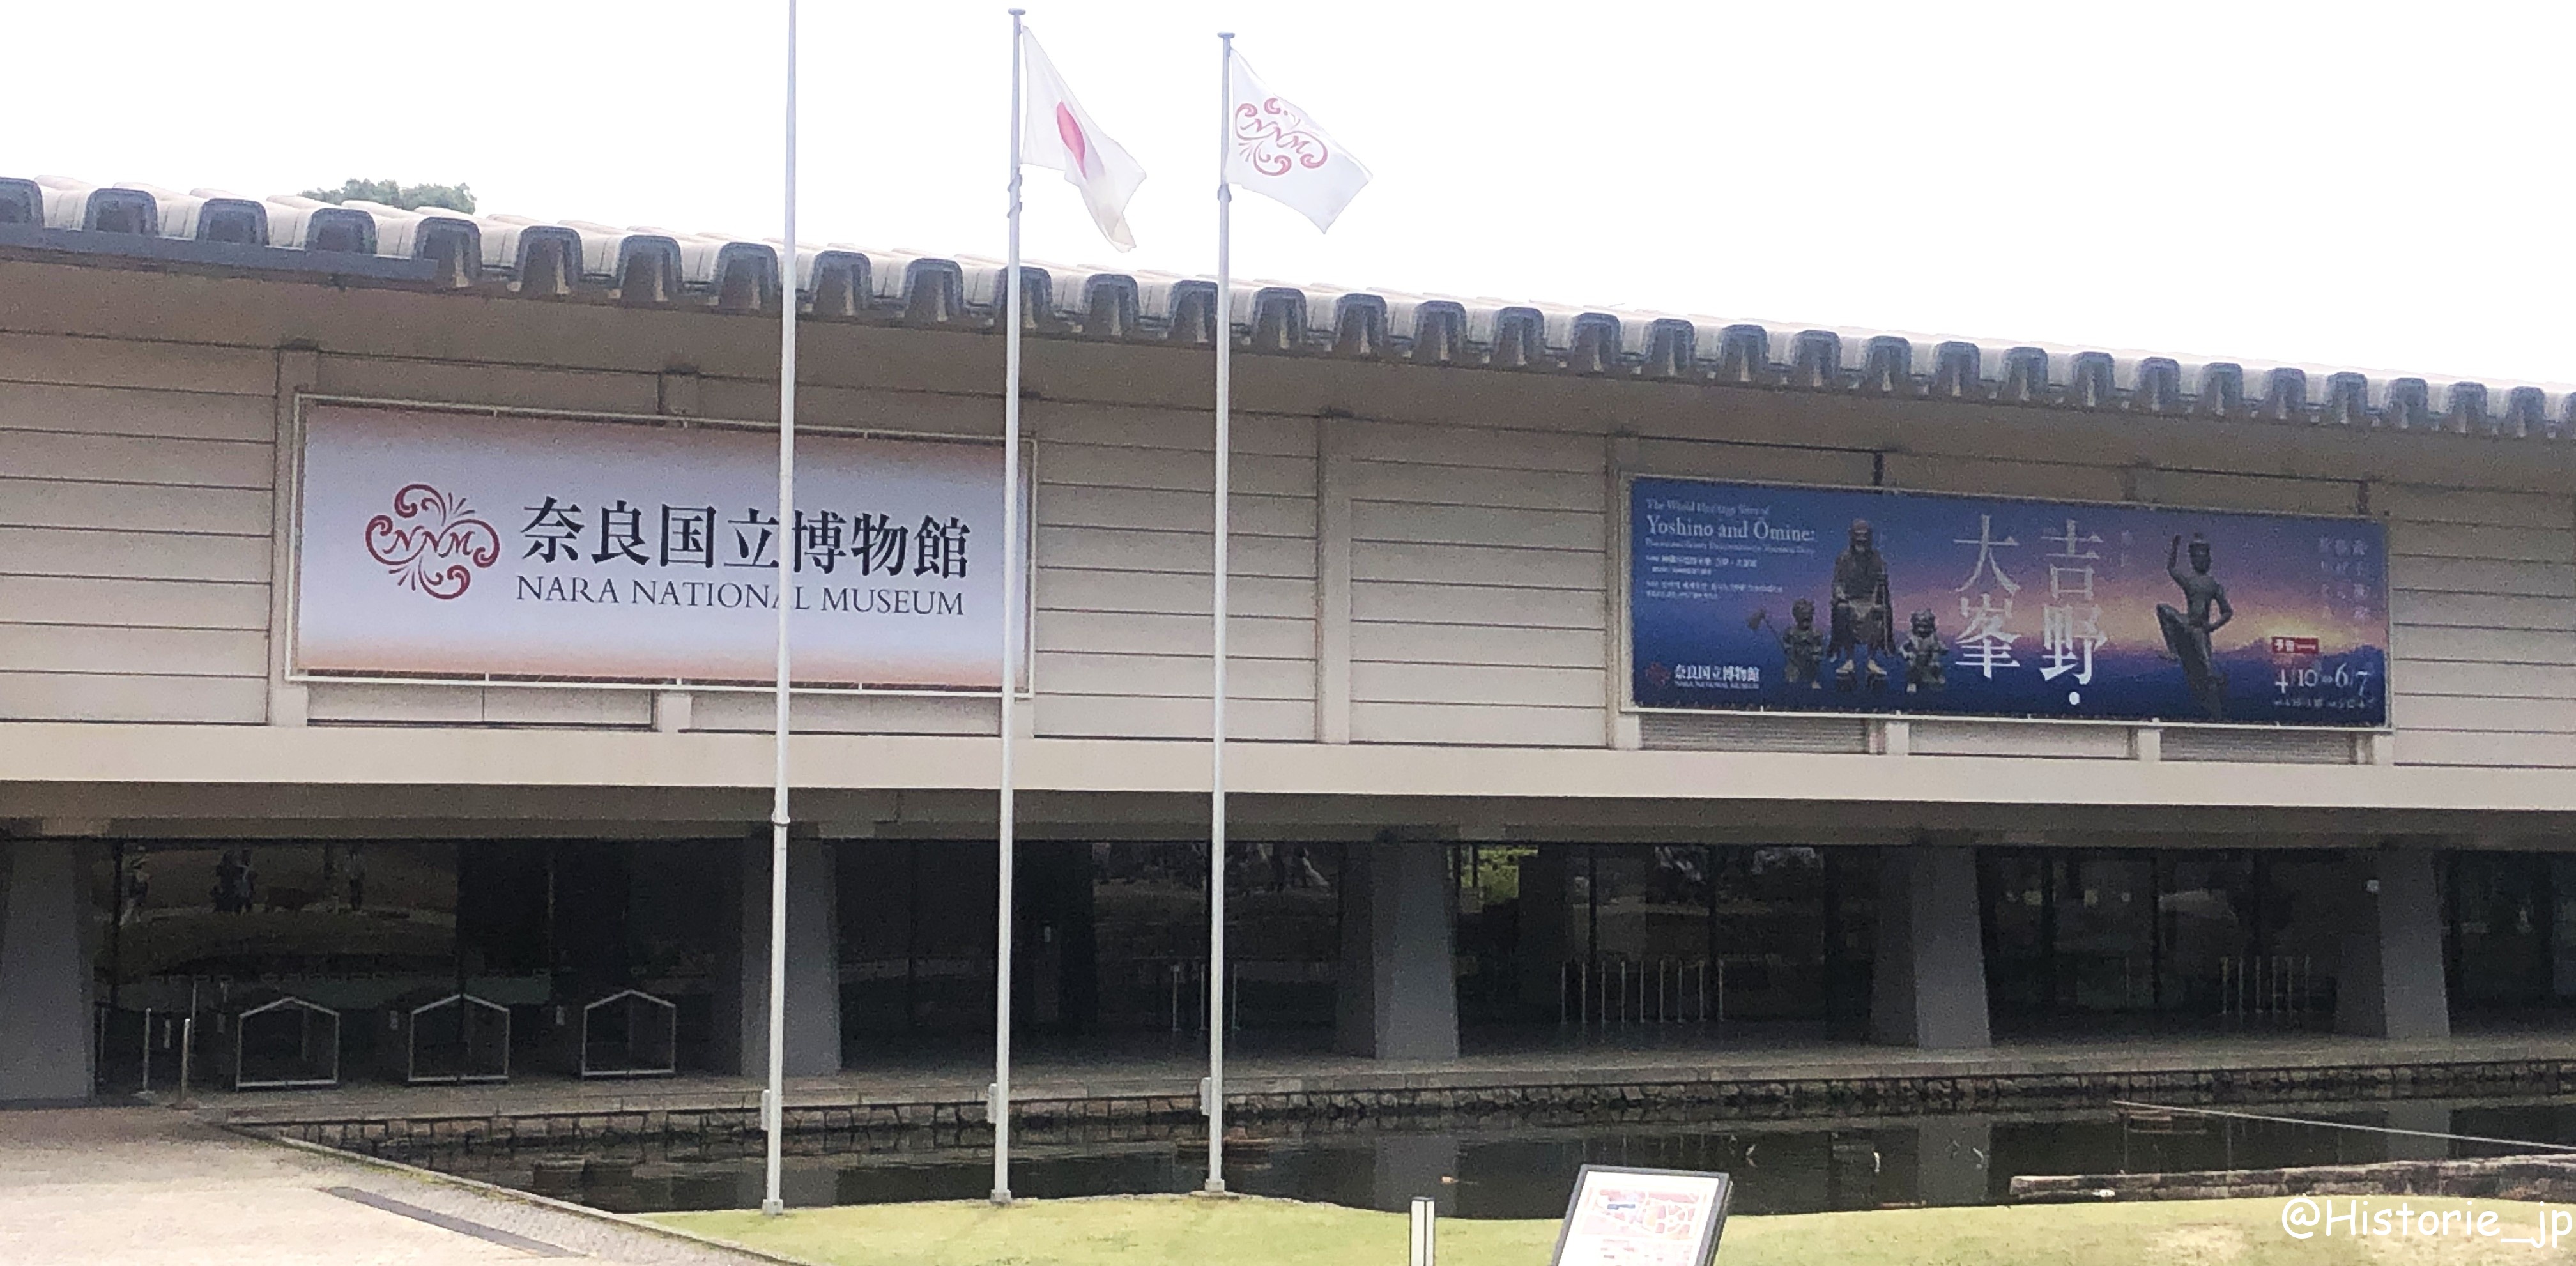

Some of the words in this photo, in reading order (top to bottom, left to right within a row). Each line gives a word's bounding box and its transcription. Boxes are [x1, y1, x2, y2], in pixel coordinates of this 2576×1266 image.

[521, 496, 970, 579] 奈良国立博物館
[1646, 514, 1714, 537] Yoshino
[1718, 520, 1748, 538] and
[517, 575, 620, 604] NARA
[821, 587, 964, 615] MUSEUM
[1952, 514, 2022, 681] 大峯
[2039, 518, 2108, 706] 吉野・
